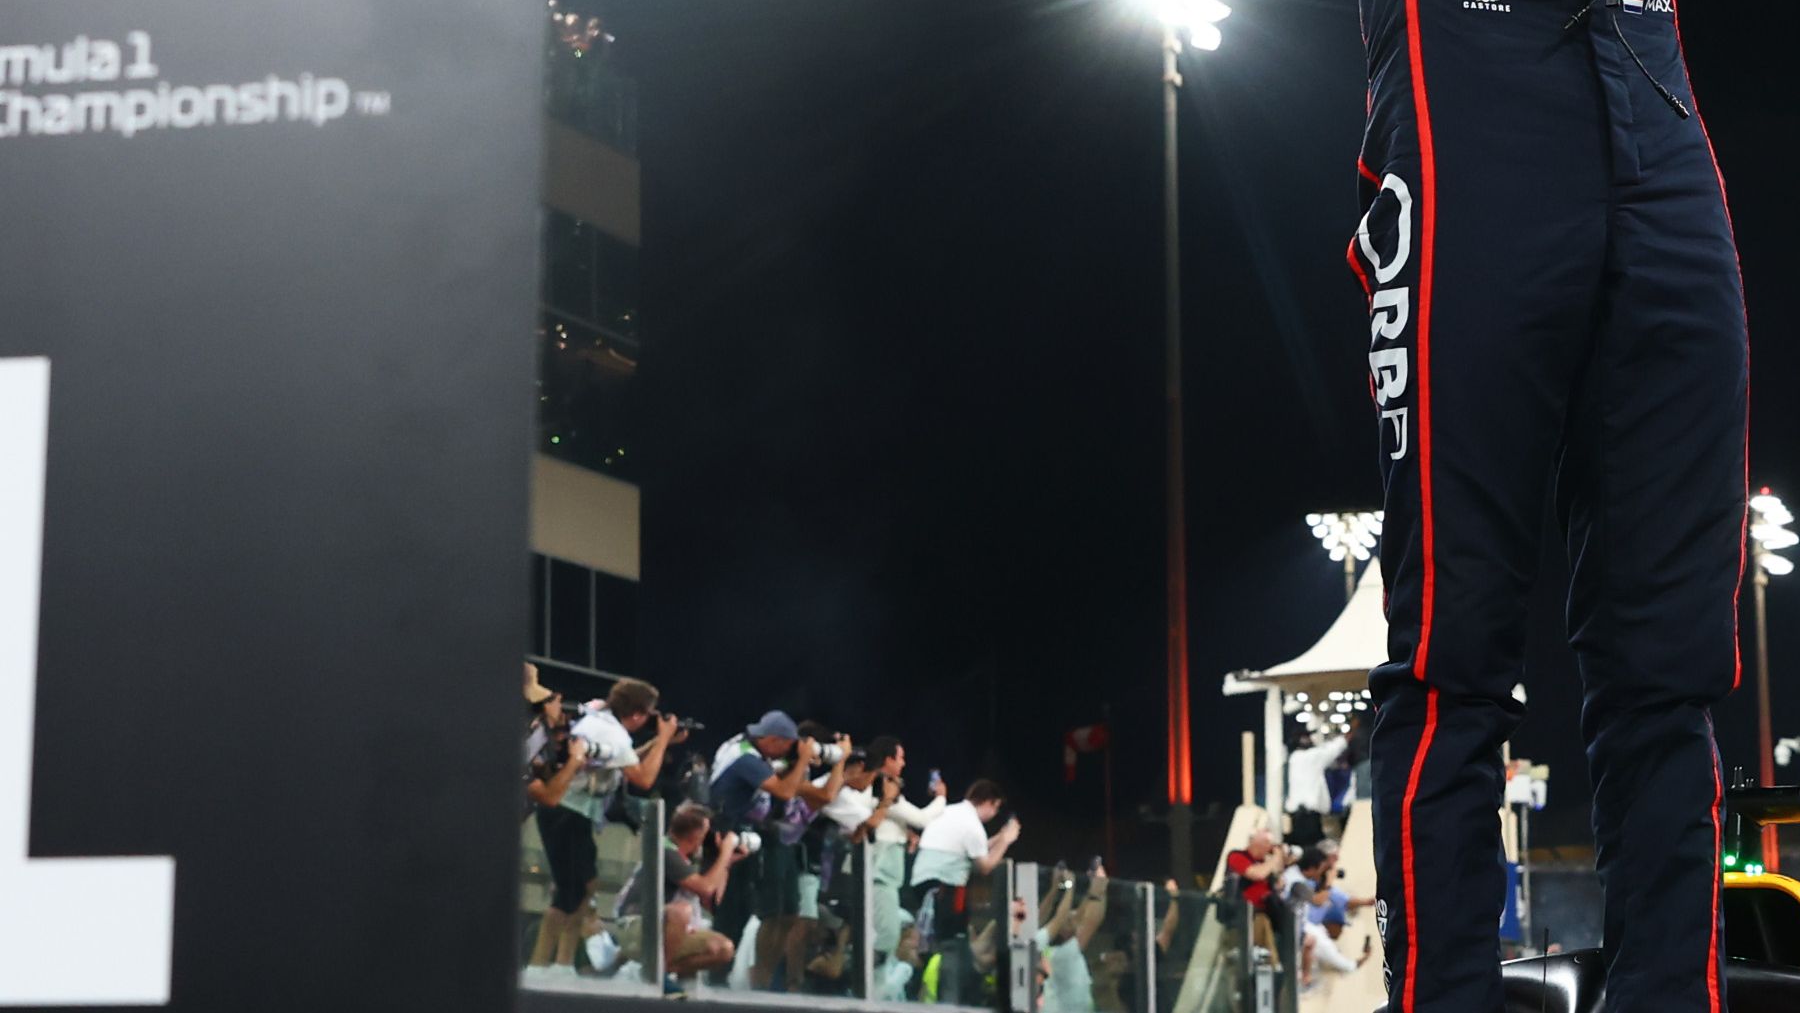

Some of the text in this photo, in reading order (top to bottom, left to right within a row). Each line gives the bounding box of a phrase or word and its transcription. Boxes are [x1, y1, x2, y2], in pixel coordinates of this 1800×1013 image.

[1462, 0, 1512, 13] CASTORE
[125, 30, 160, 79] 1
[0, 72, 351, 138] hampionship
